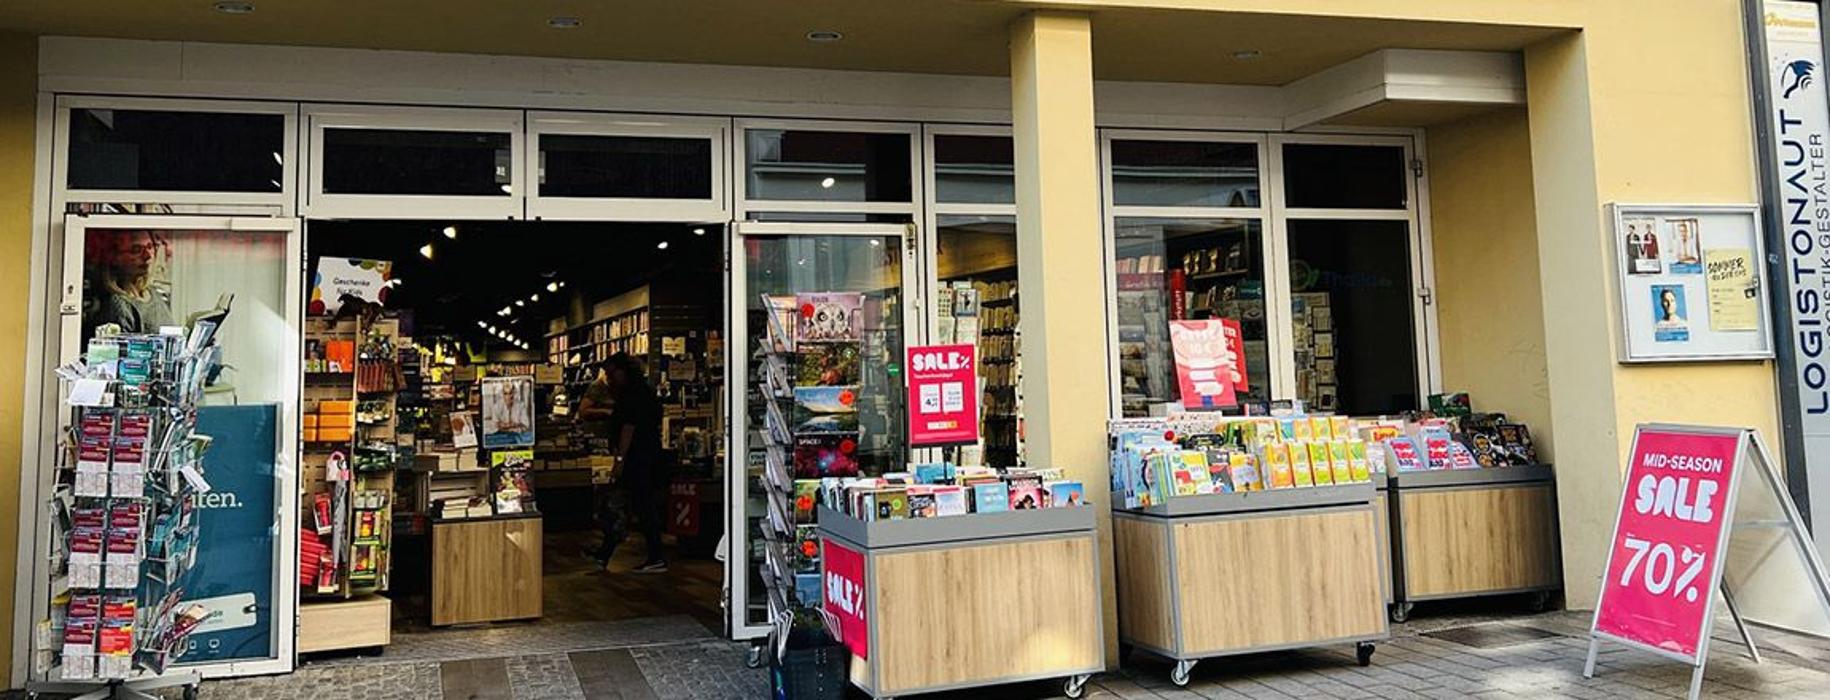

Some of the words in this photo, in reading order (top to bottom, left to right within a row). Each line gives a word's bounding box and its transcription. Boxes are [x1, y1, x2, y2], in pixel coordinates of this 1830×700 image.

[1779, 108, 1829, 415] LOGISTONAUT
[1643, 453, 1722, 474] MID-SEASON
[1635, 474, 1719, 523] SALE
[1619, 536, 1707, 603] 70%
